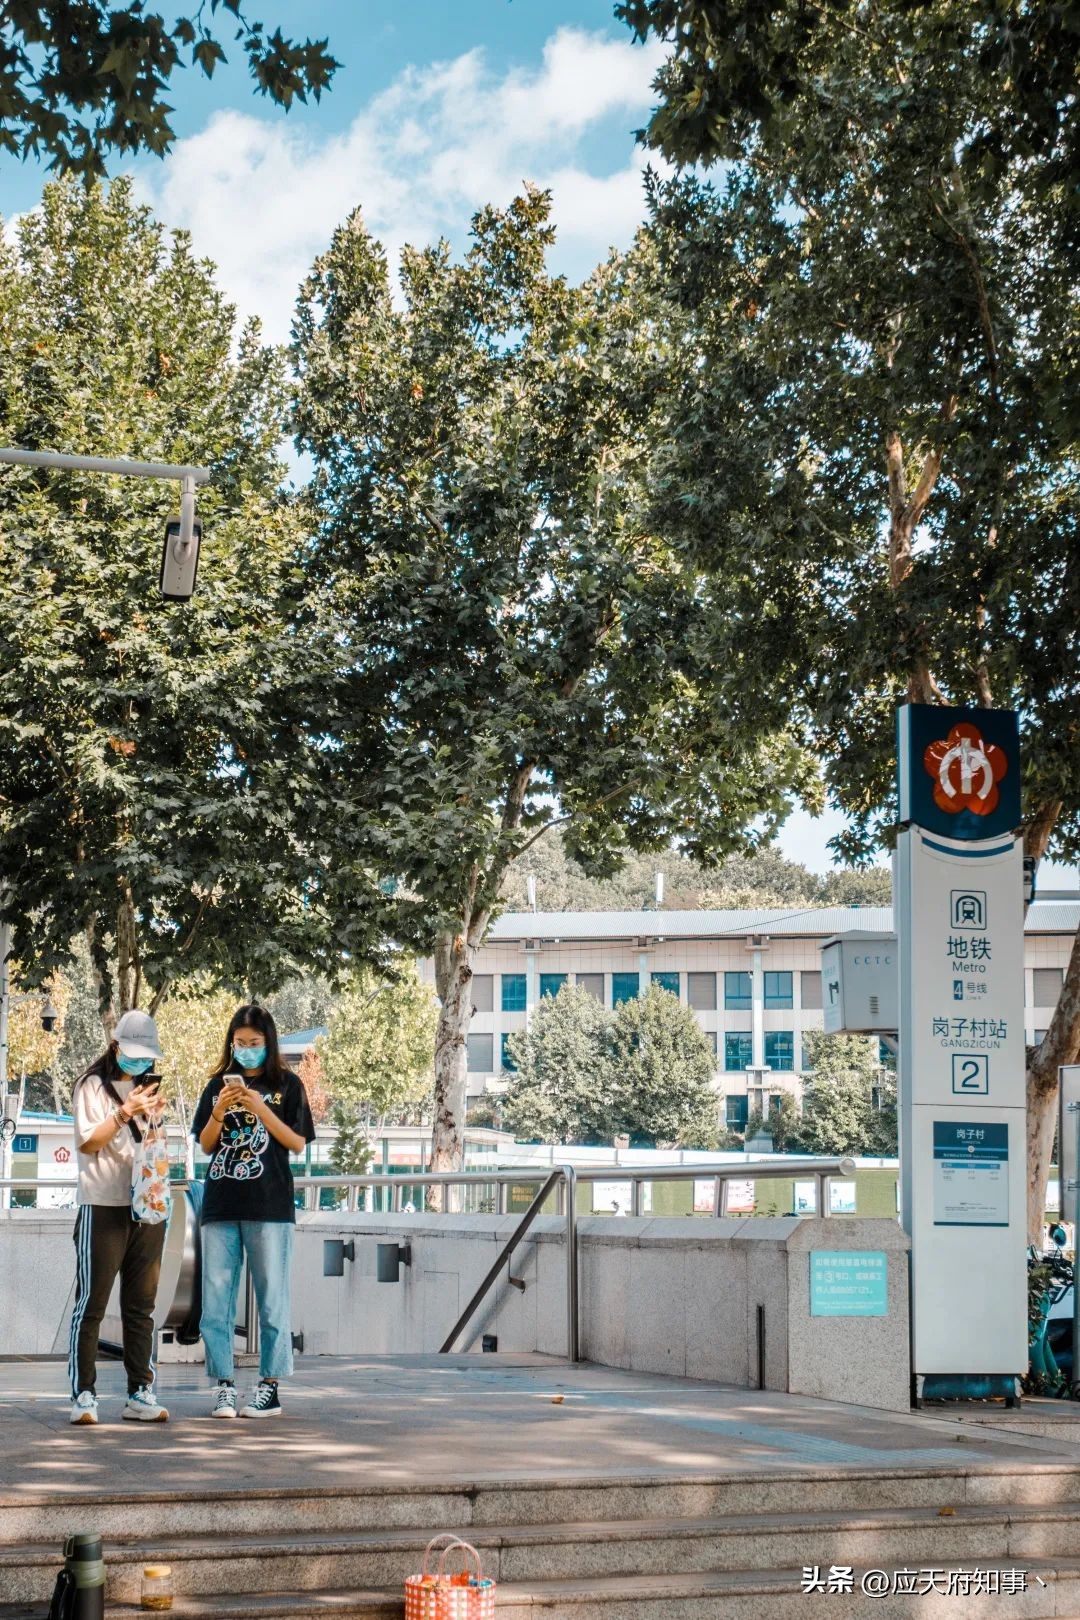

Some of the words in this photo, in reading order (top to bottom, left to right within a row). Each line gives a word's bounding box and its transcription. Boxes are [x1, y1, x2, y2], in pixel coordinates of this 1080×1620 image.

[946, 936, 992, 960] 地铁
[952, 961, 986, 973] Metro
[954, 981, 963, 999] 4
[967, 982, 987, 993] 号线
[932, 1016, 1007, 1039] 岗子村站
[940, 1039, 1001, 1049] GANGZICUN
[961, 1060, 980, 1088] 2
[956, 1129, 985, 1140] 岗子村
